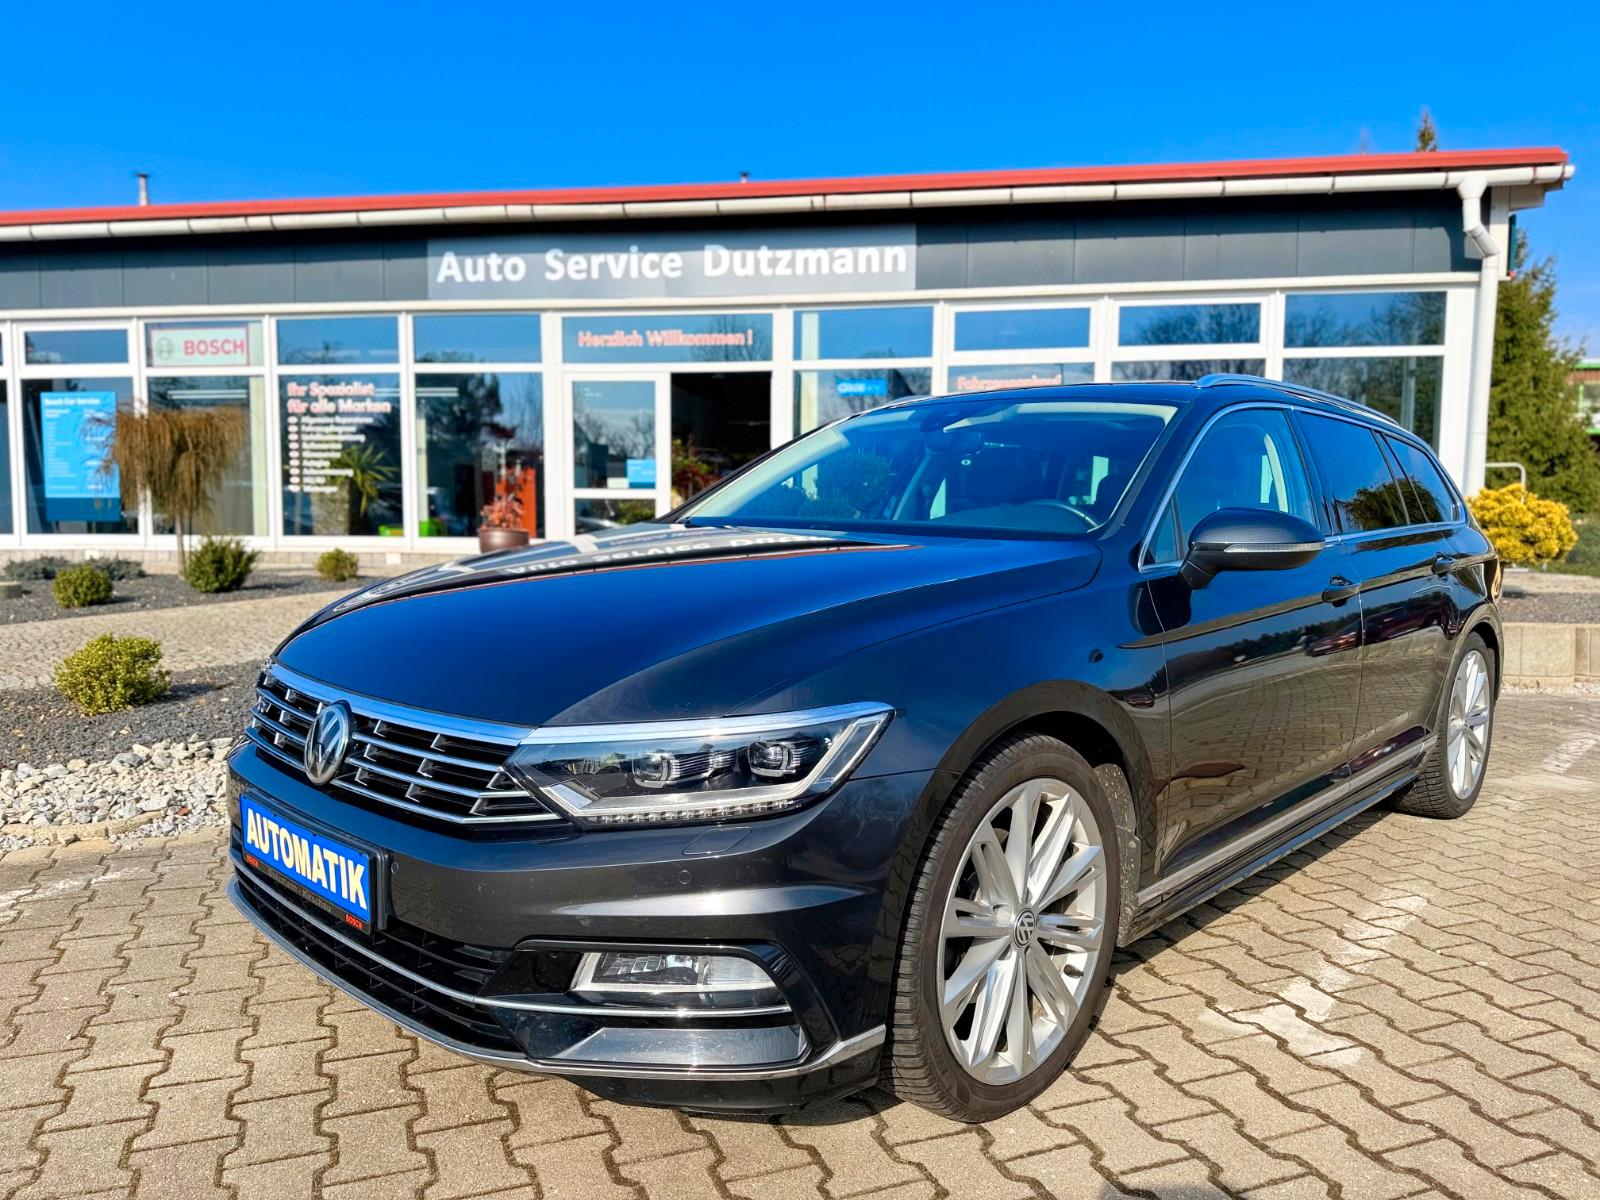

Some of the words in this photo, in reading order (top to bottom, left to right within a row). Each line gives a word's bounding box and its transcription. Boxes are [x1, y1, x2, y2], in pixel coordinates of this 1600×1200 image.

[436, 251, 526, 283] Auto
[544, 245, 684, 280] Service
[703, 244, 907, 278] Dutzmann
[578, 330, 643, 347] Herzlich
[646, 329, 744, 346] Willkommen
[183, 338, 245, 357] BOSCH
[287, 382, 307, 396] Ihr
[310, 382, 374, 398] Spezialist
[310, 398, 336, 413] alle
[338, 398, 391, 413] Marken
[246, 808, 369, 911] AUTOMATIK
